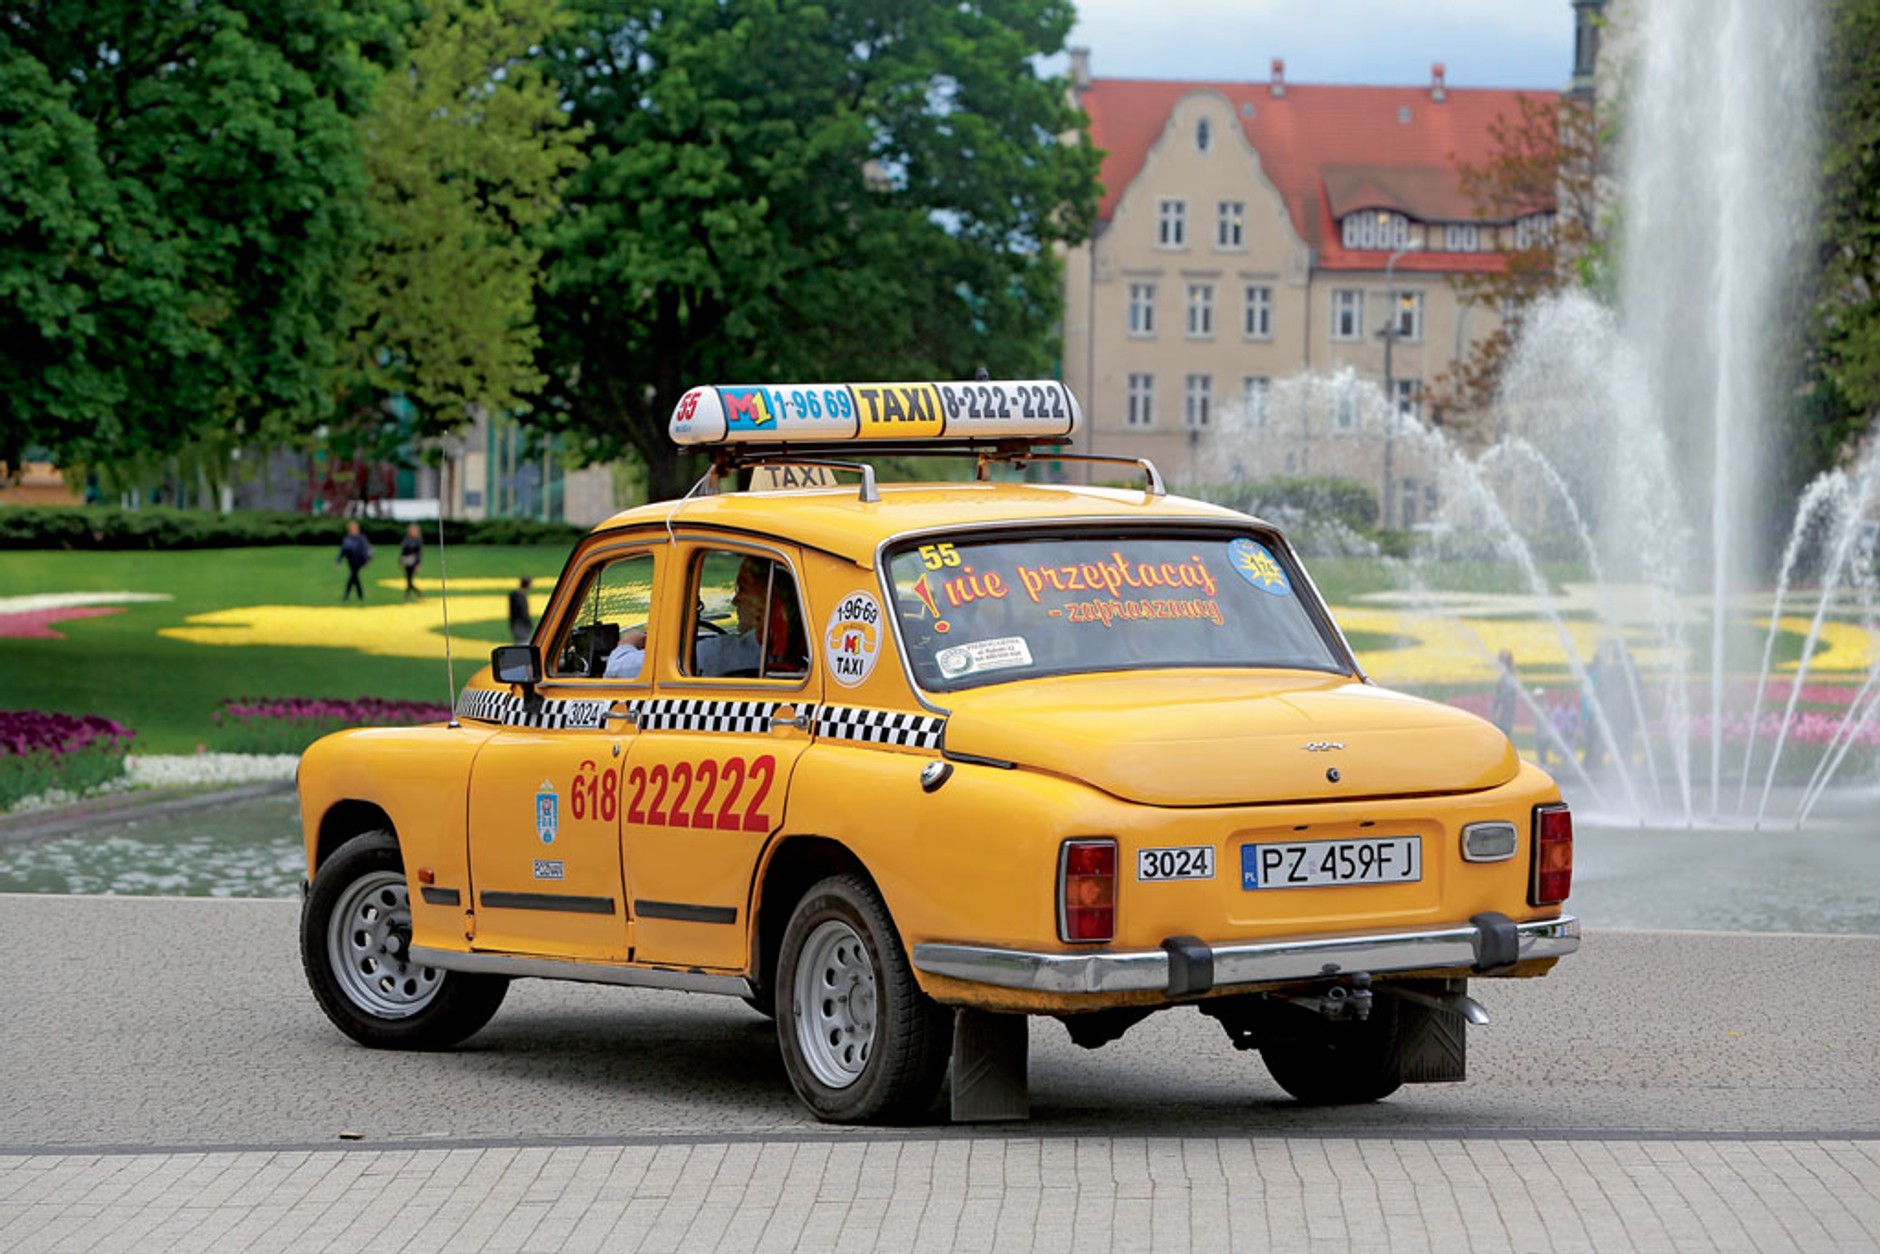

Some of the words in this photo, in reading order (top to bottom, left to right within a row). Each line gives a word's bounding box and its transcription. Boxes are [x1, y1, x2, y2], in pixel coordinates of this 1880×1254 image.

[676, 392, 702, 421] 55
[723, 390, 772, 426] M1
[859, 388, 936, 423] TAXI
[942, 385, 1065, 419] 8-222-222
[764, 466, 826, 487] TAXI
[918, 543, 961, 571] 55
[944, 565, 1009, 607] nie
[1015, 551, 1217, 604] przepłacaj
[837, 656, 864, 676] TAXI
[569, 703, 600, 725] 3024
[571, 767, 617, 822] 618
[627, 754, 776, 833] 222222
[1143, 849, 1208, 877] 3024
[1262, 847, 1308, 884] PZ
[1320, 842, 1411, 880] 459FJ
